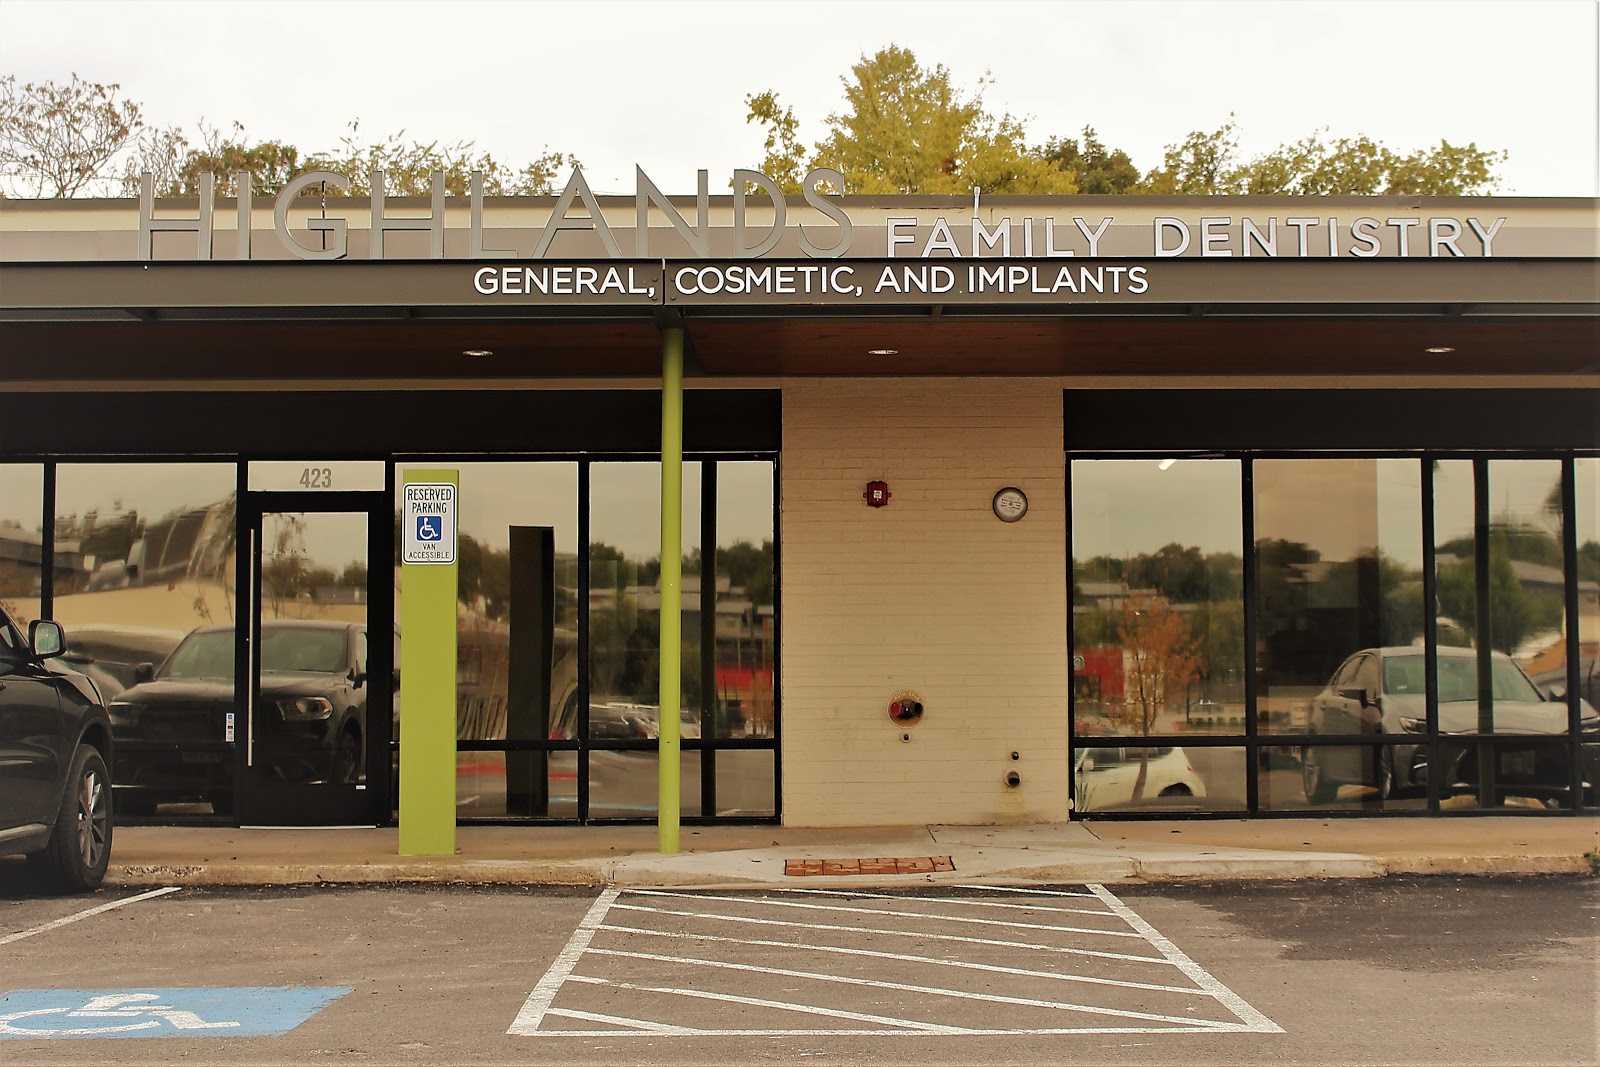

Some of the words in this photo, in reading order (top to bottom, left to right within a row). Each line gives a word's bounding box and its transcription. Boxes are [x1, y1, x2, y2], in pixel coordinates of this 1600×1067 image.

[139, 164, 853, 259] HIGHLANDS
[886, 217, 1113, 257] FAMILY
[1153, 217, 1506, 258] DENTISTRY
[474, 267, 656, 298] GENERAL,
[674, 266, 863, 298] COSMETIC,
[874, 265, 955, 294] AND
[968, 264, 1149, 294] IMPLANTS
[299, 468, 332, 488] 423
[407, 488, 452, 501] RESERVED
[412, 502, 447, 513] PARKING
[408, 551, 450, 559] ACCESSIBLE
[422, 543, 436, 551] VAN
